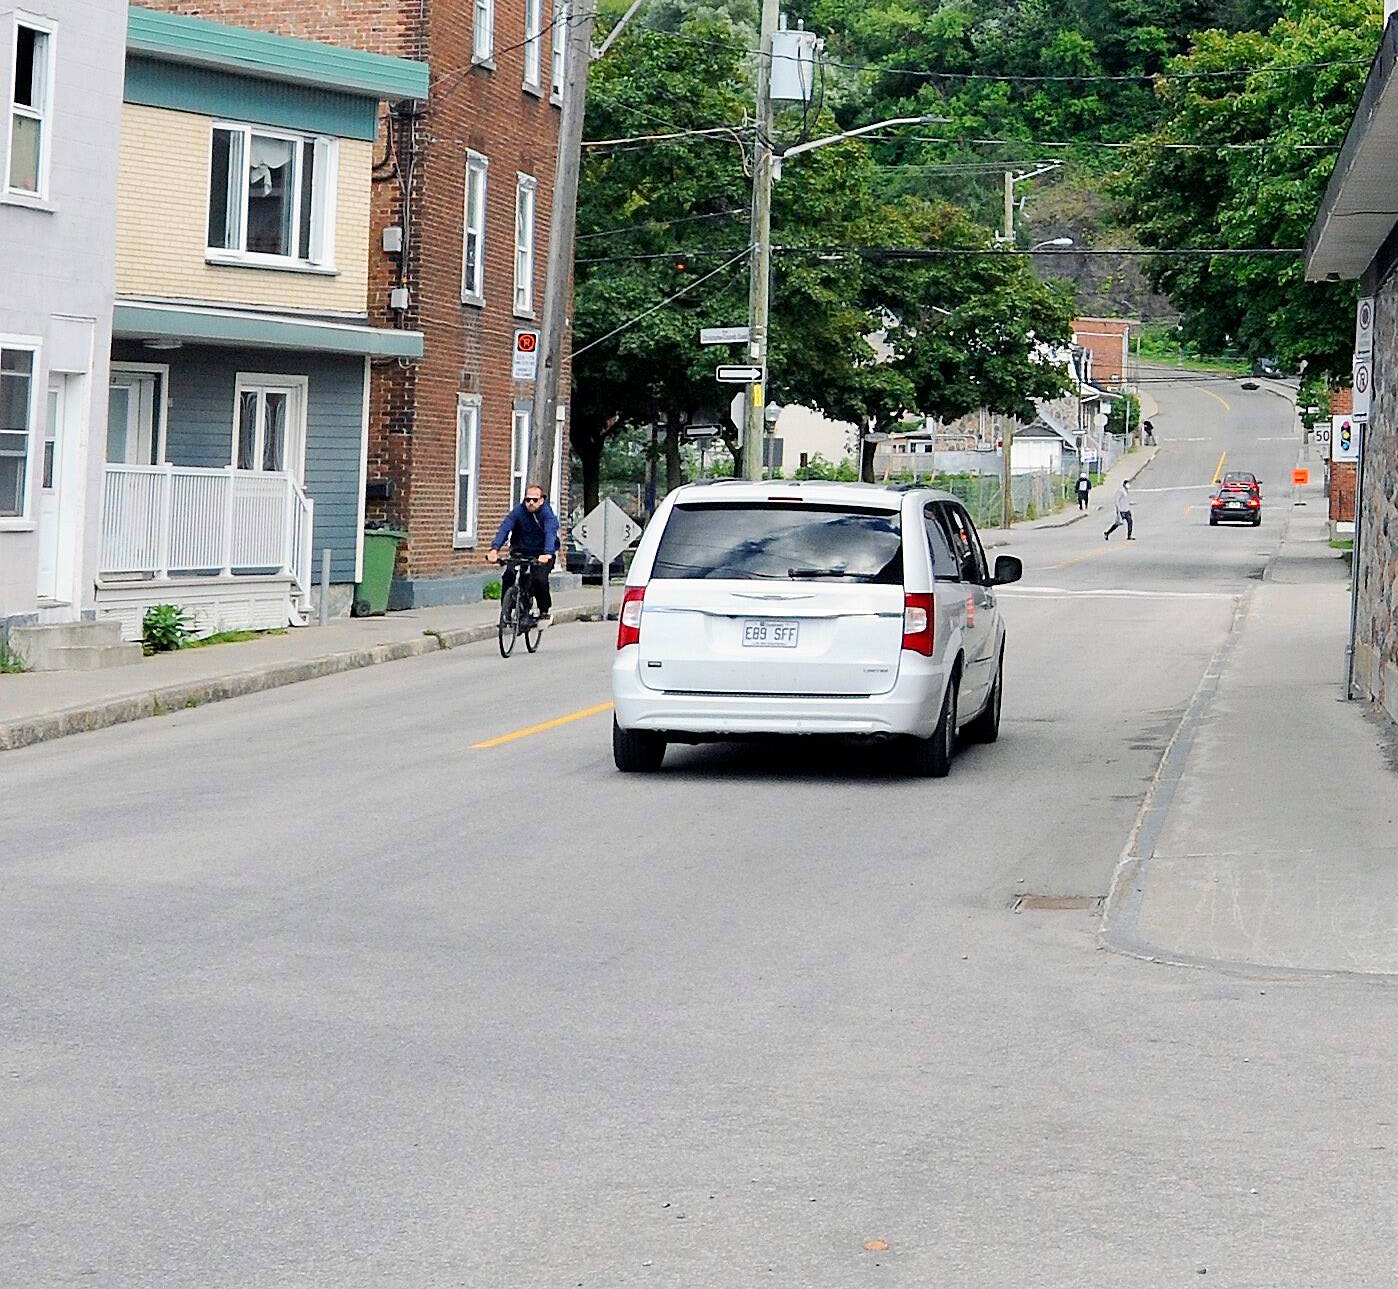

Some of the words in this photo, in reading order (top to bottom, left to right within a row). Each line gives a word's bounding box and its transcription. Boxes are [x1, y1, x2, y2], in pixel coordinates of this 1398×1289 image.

[1316, 430, 1330, 442] 50
[745, 626, 767, 640] E89
[774, 627, 796, 641] SFF
